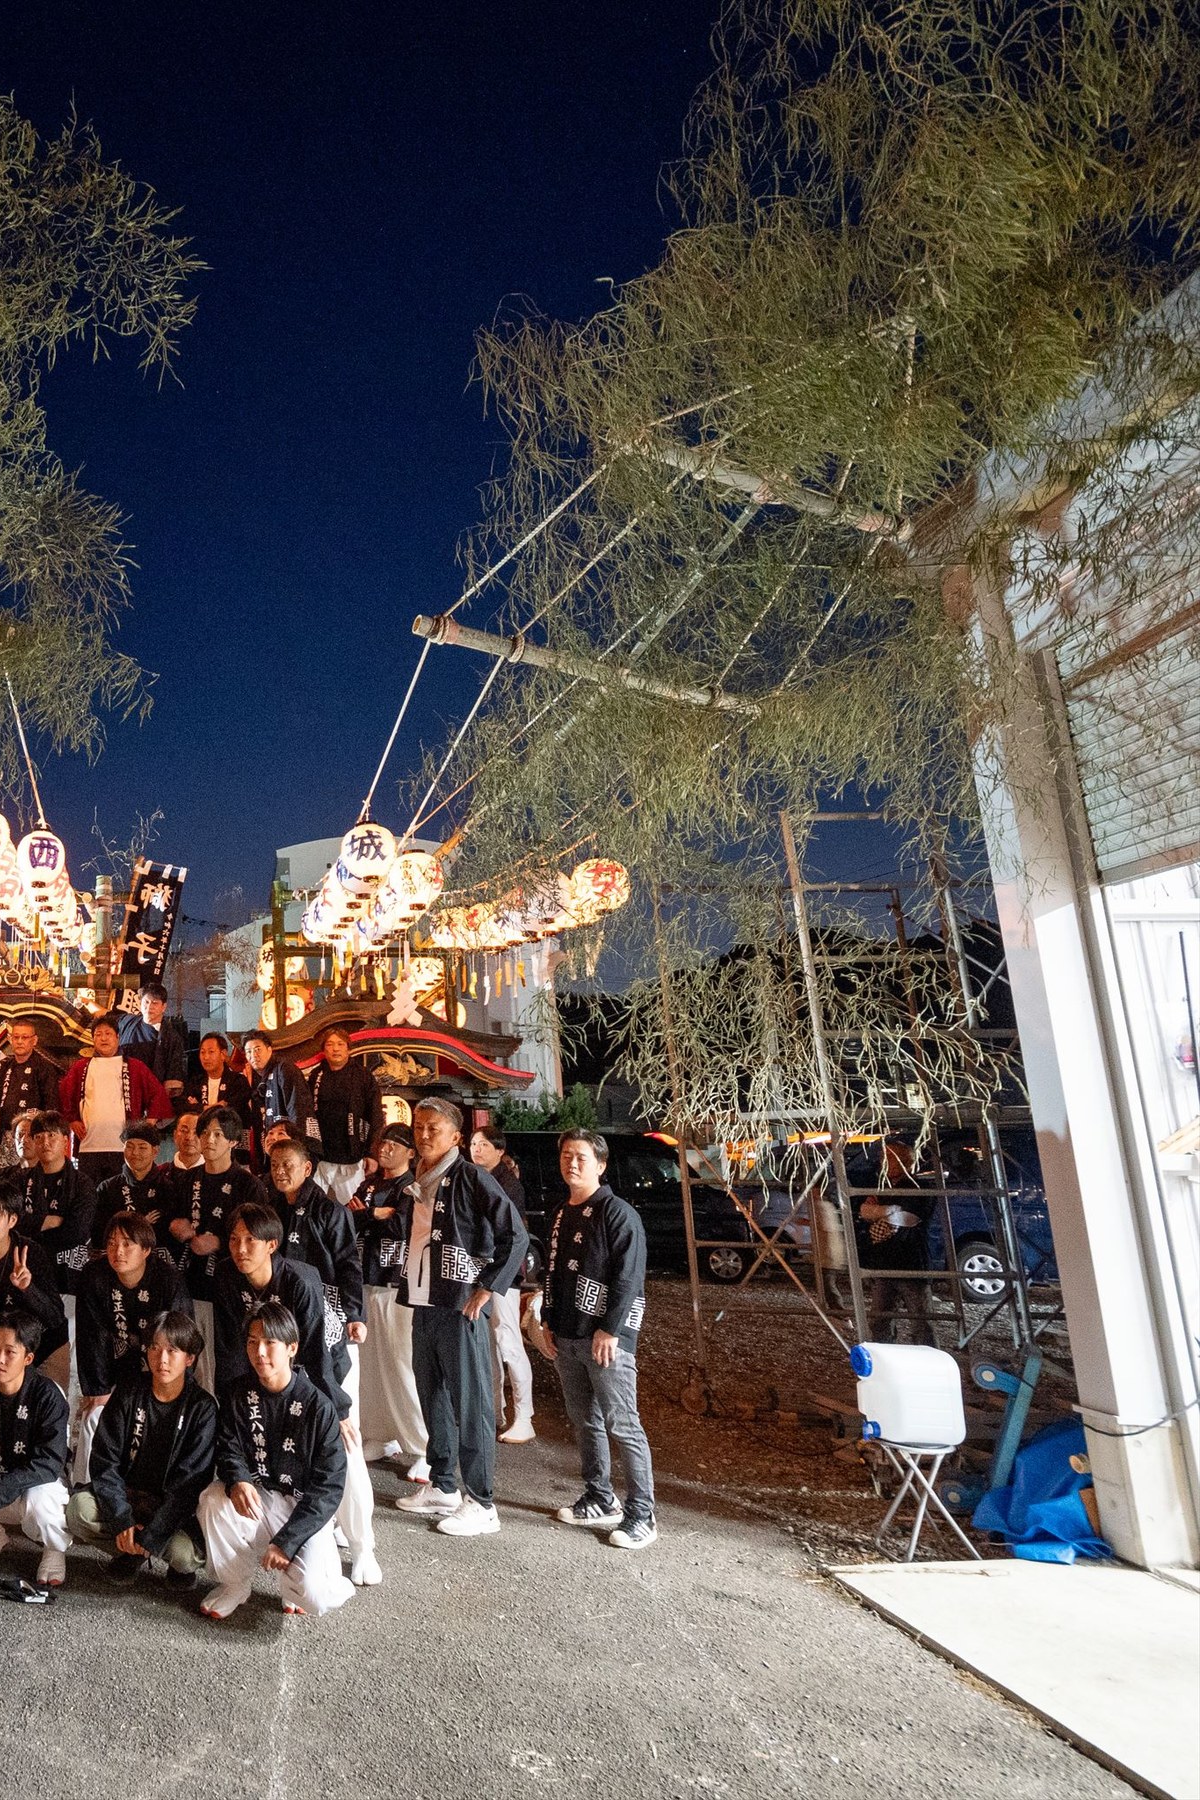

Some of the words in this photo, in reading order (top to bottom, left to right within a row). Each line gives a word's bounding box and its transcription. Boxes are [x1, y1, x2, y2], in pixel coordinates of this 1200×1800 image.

[28, 836, 60, 871] 西
[345, 829, 387, 861] 城
[247, 1391, 270, 1478] 海正八幡神社
